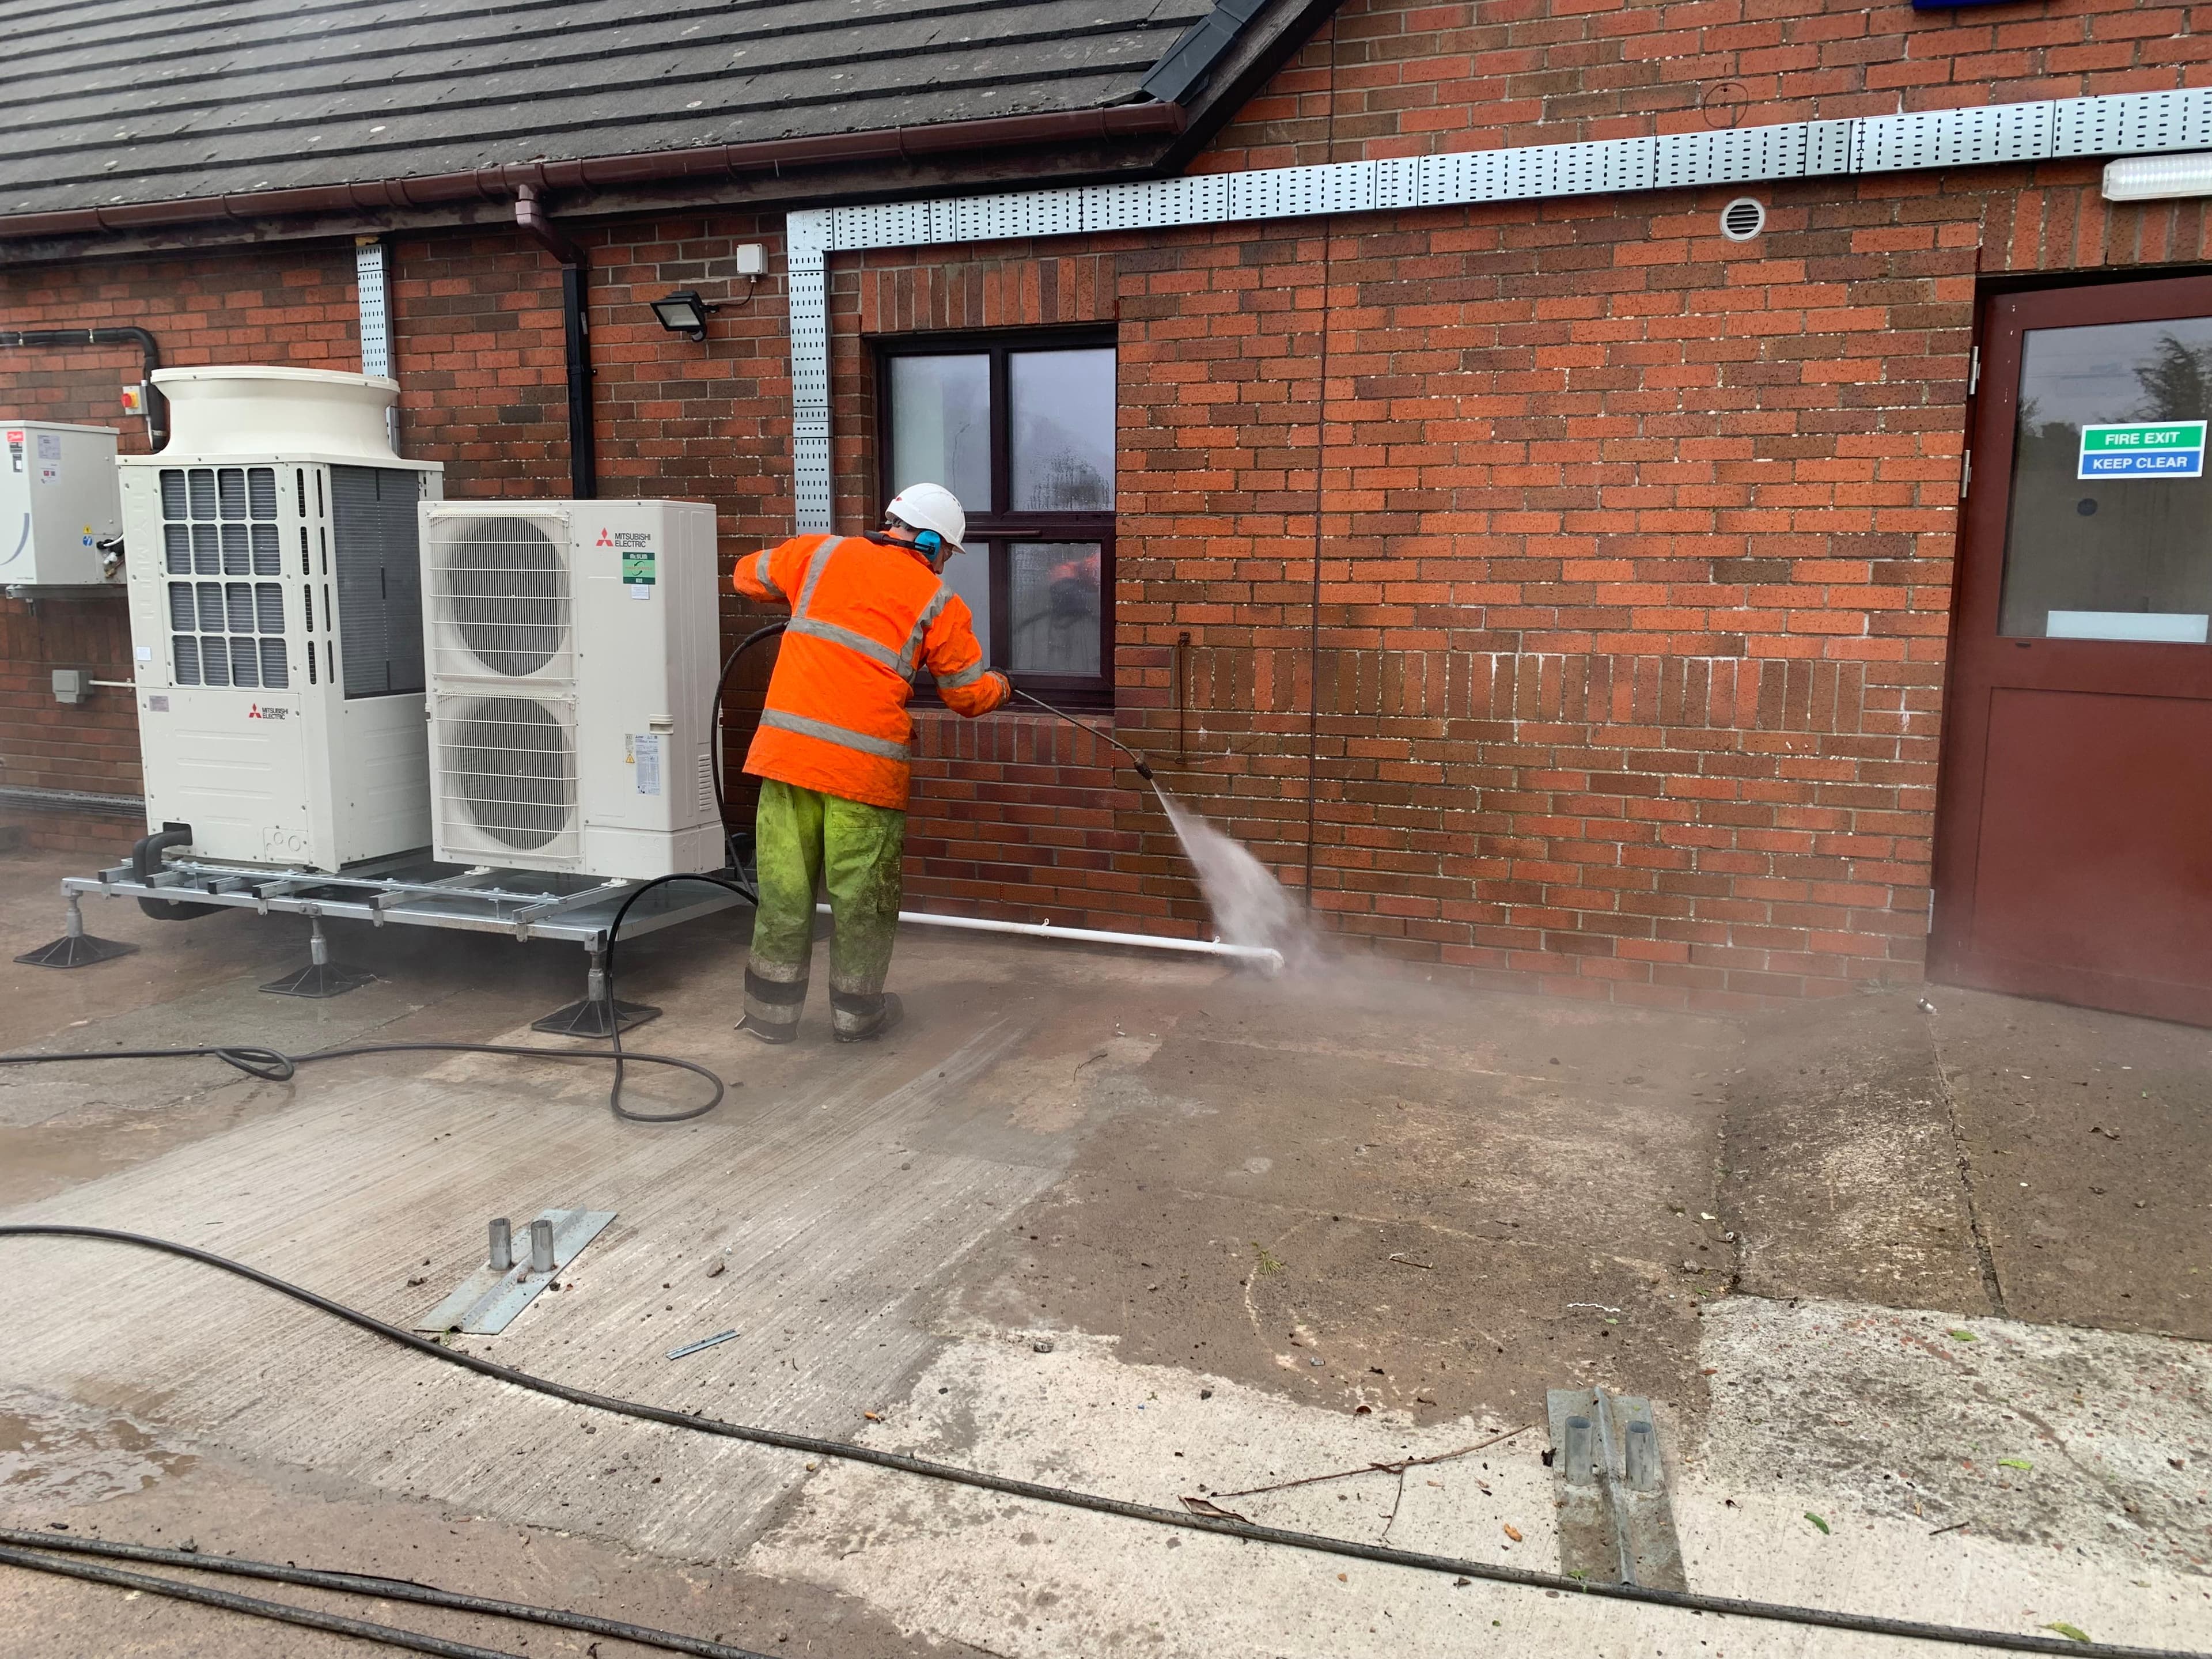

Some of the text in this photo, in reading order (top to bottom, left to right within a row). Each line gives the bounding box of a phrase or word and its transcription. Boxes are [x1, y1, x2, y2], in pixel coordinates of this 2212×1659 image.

[2105, 431, 2180, 445] FIRE EXIT
[2093, 456, 2188, 469] KEEP CLEAR
